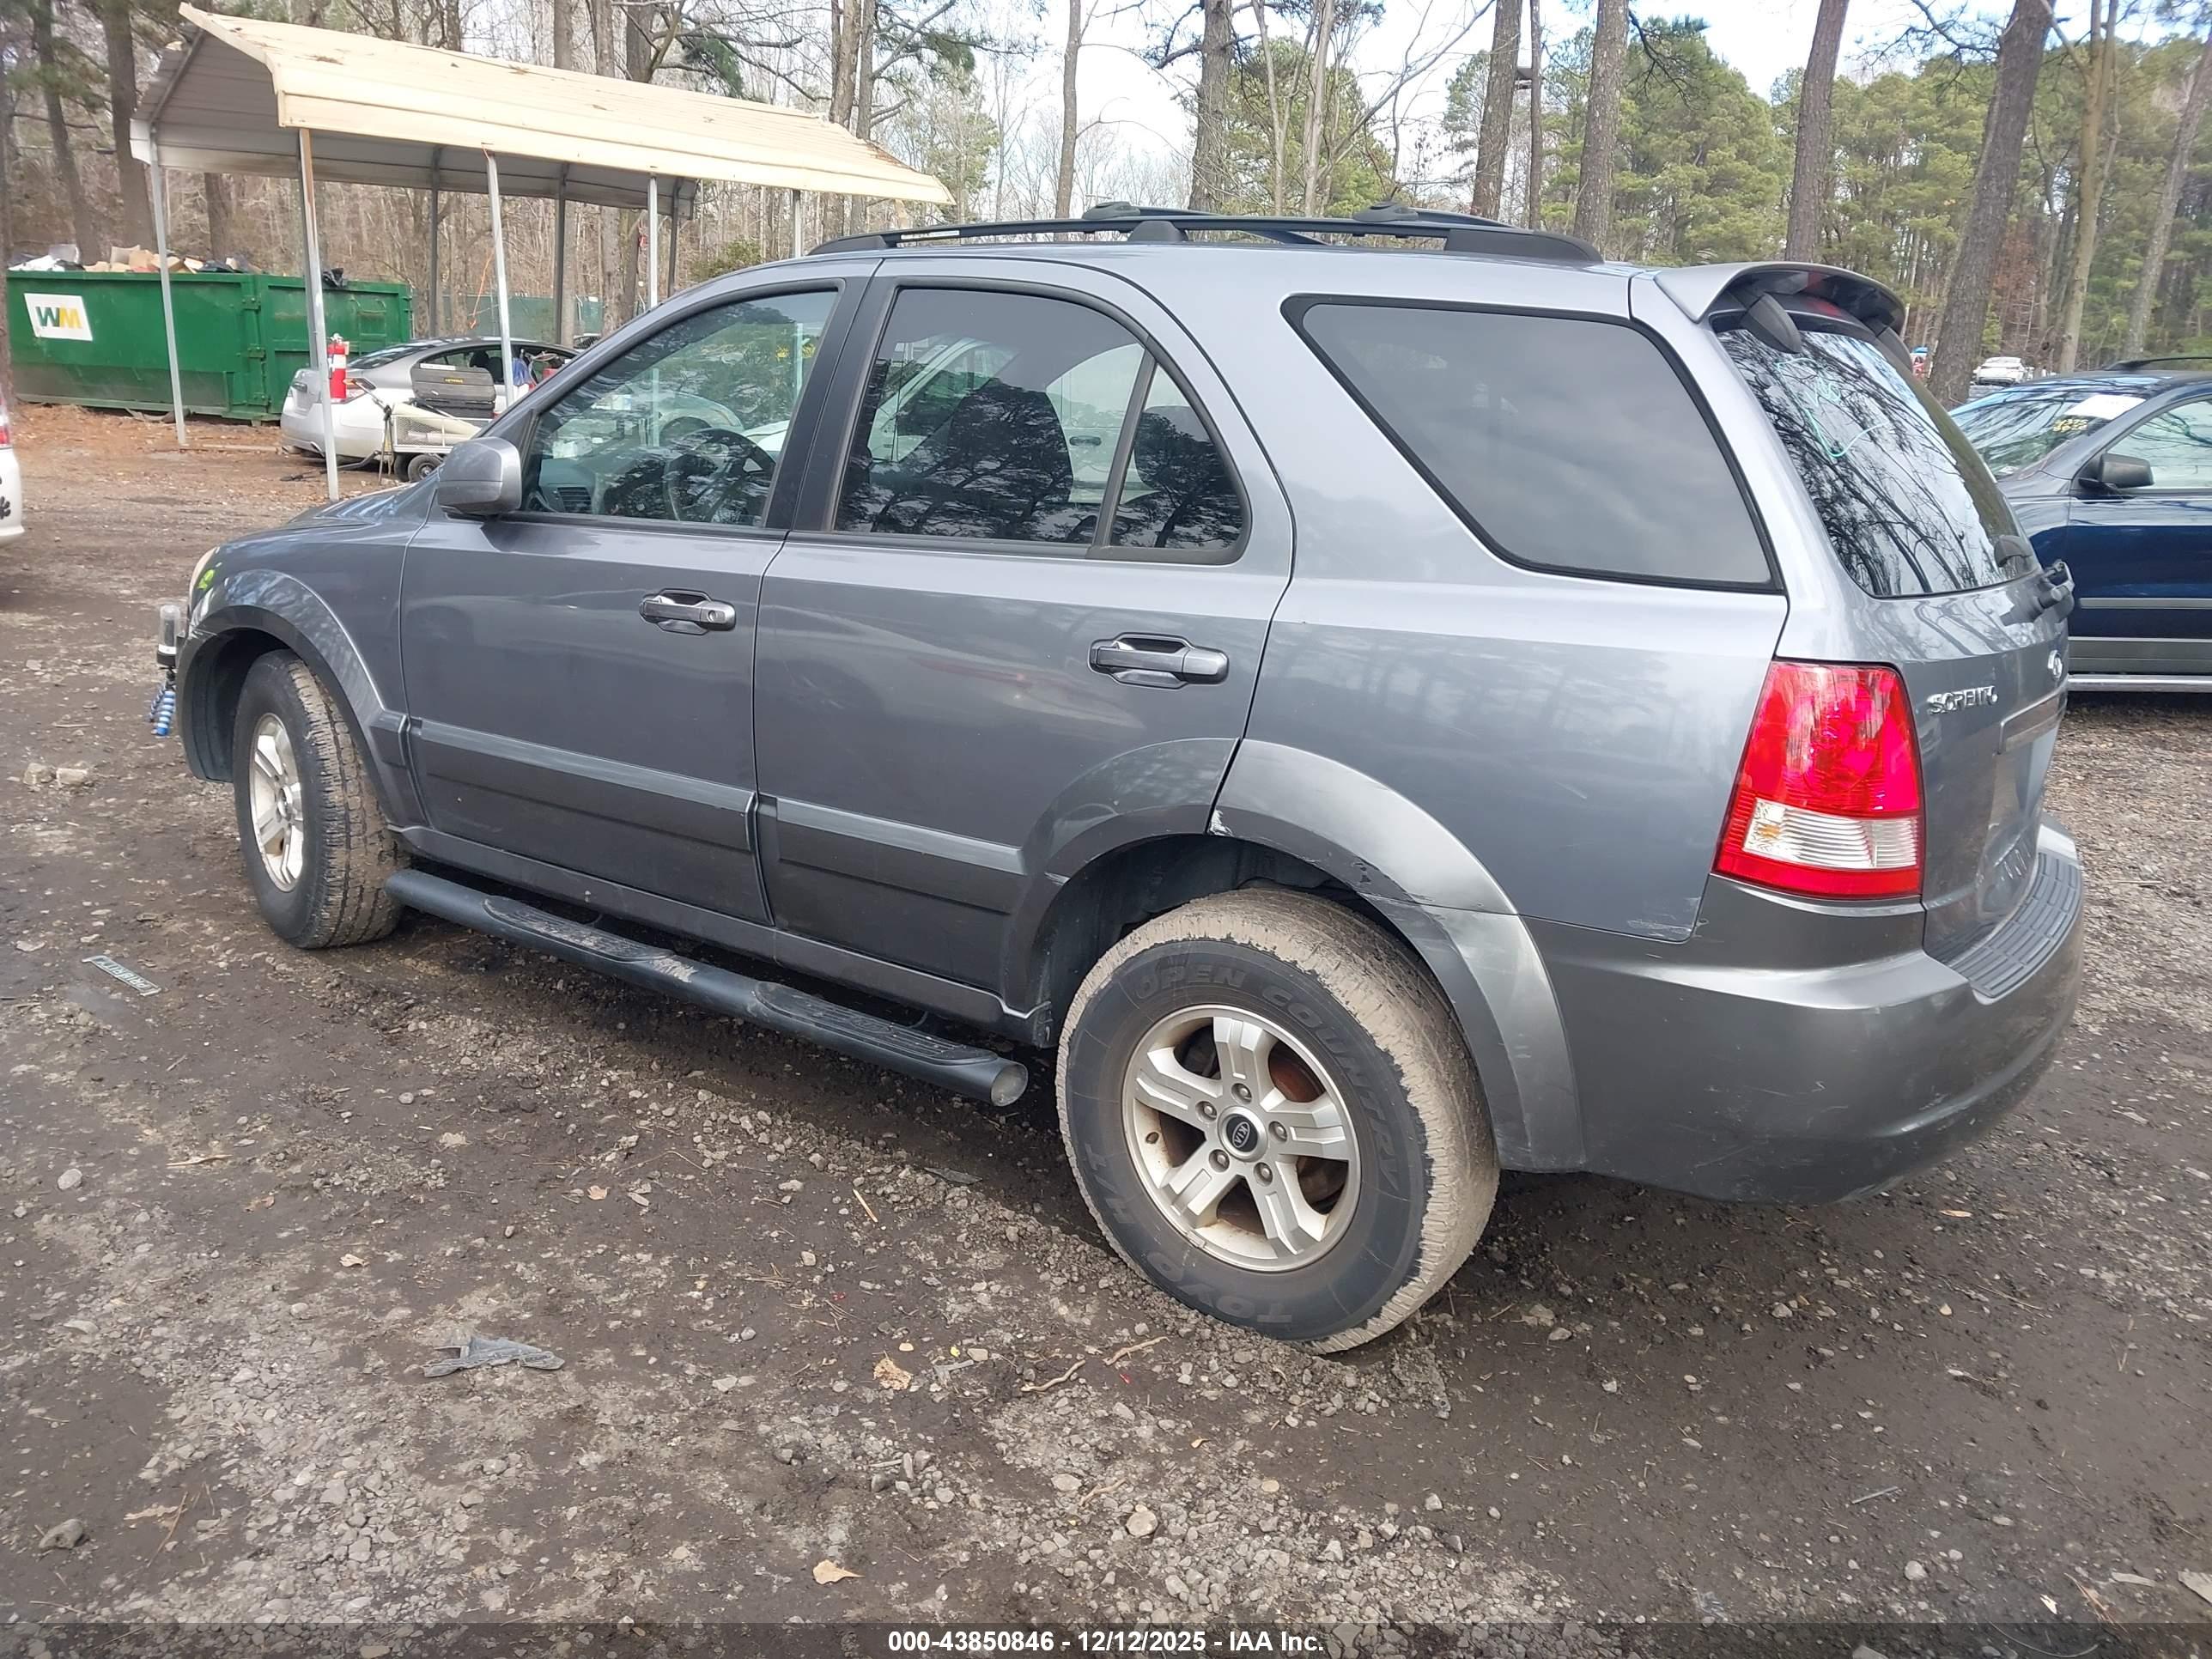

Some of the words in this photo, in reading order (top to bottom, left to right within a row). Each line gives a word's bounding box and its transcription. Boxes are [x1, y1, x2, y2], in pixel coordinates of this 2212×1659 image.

[36, 306, 82, 329] WM
[1134, 963, 1245, 998] OPEN
[1234, 1126, 1248, 1144] KIA
[1147, 1251, 1292, 1323] TOYO
